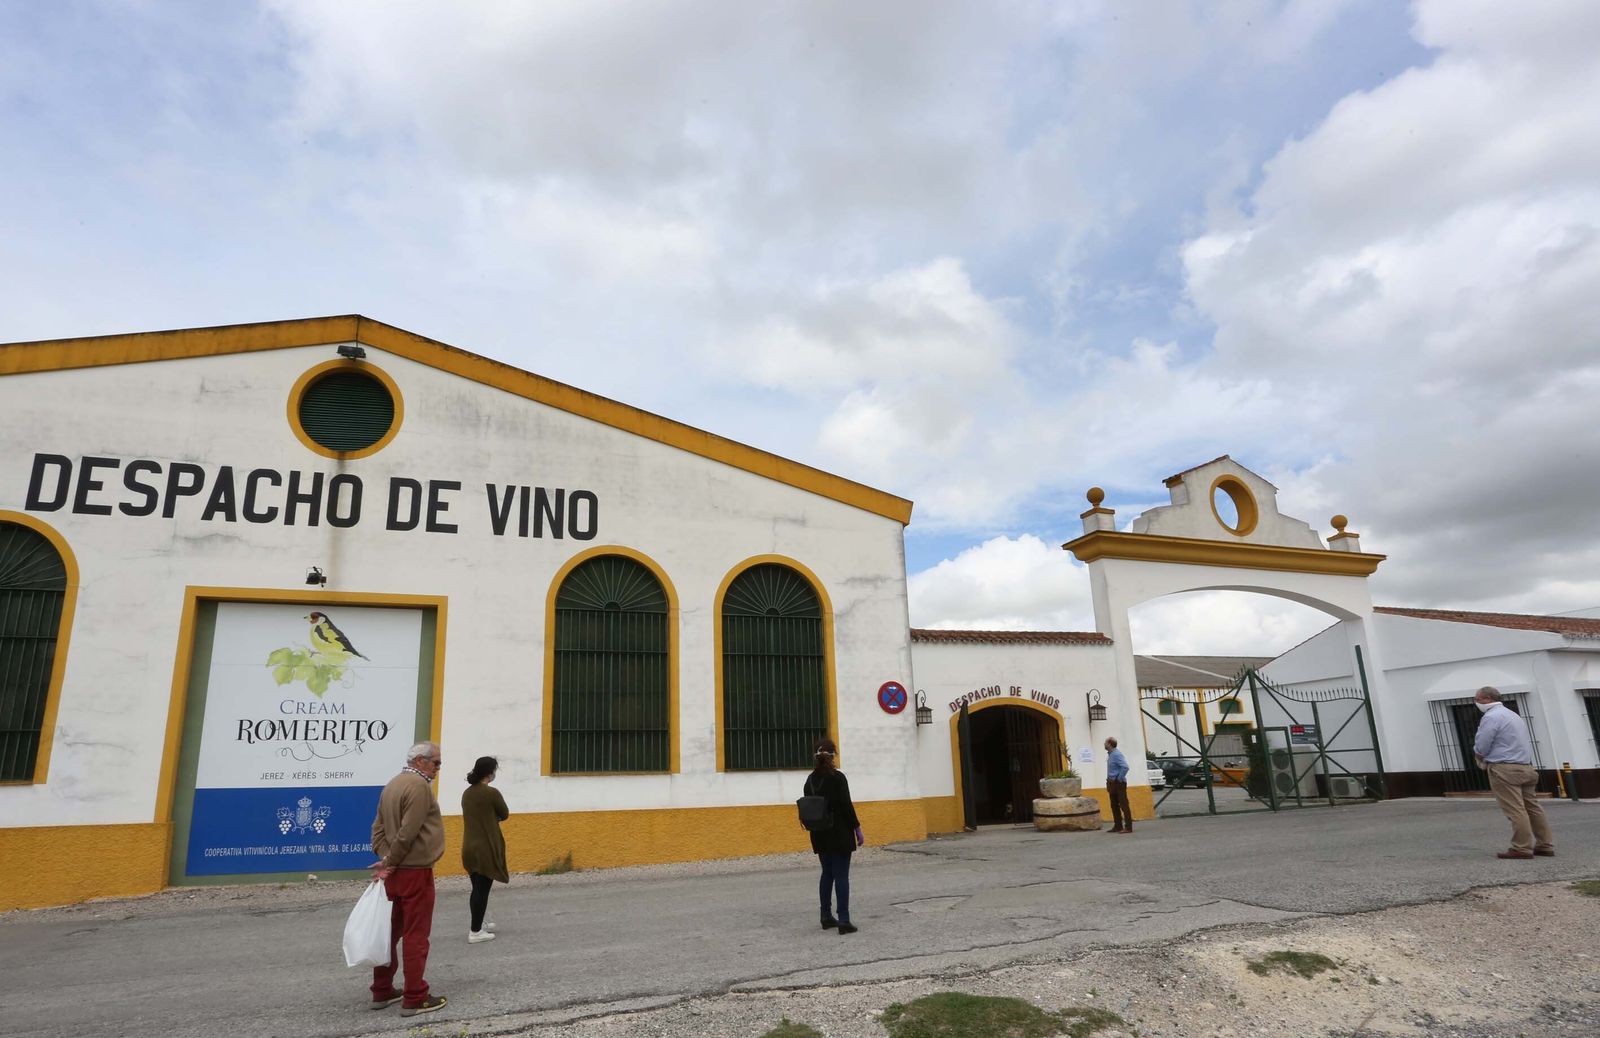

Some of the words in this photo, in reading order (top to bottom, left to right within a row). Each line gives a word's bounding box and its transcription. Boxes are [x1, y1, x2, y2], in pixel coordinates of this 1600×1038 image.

[25, 453, 364, 528] DESPACHO
[386, 477, 462, 534] DE
[486, 483, 599, 541] VINO
[949, 685, 1001, 712] DESPACHO
[1010, 686, 1022, 697] DE
[1031, 689, 1060, 709] VINOS
[235, 718, 391, 745] ROMERITO
[260, 772, 285, 780] JEREZ
[324, 771, 354, 779] SHERRY
[204, 847, 242, 857] COOPERATIVA
[280, 845, 307, 855] JEREZANA
[342, 843, 350, 853] DE
[350, 843, 361, 852] LAS
